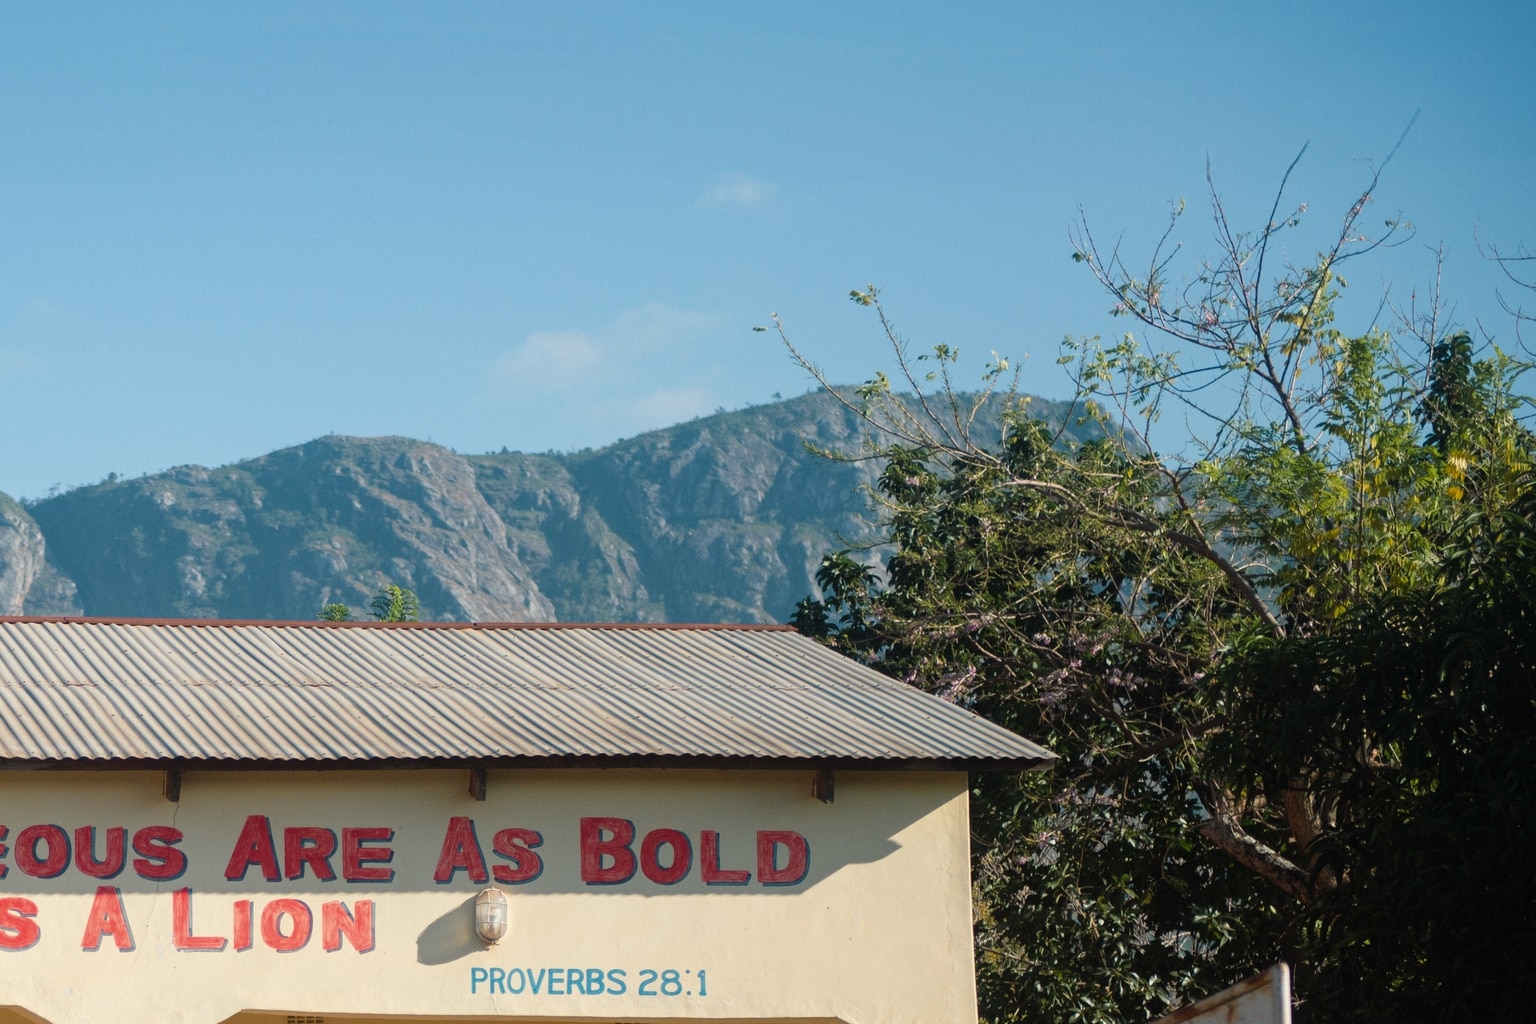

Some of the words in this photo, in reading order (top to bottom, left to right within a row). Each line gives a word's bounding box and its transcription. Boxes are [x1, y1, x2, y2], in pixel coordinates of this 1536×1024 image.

[223, 814, 396, 884] ARE
[432, 815, 545, 886] AS
[578, 815, 811, 888] BOLD
[80, 884, 136, 954] A
[170, 884, 377, 954] LION
[471, 967, 628, 997] PROVERBS
[637, 968, 708, 998] 28:1
